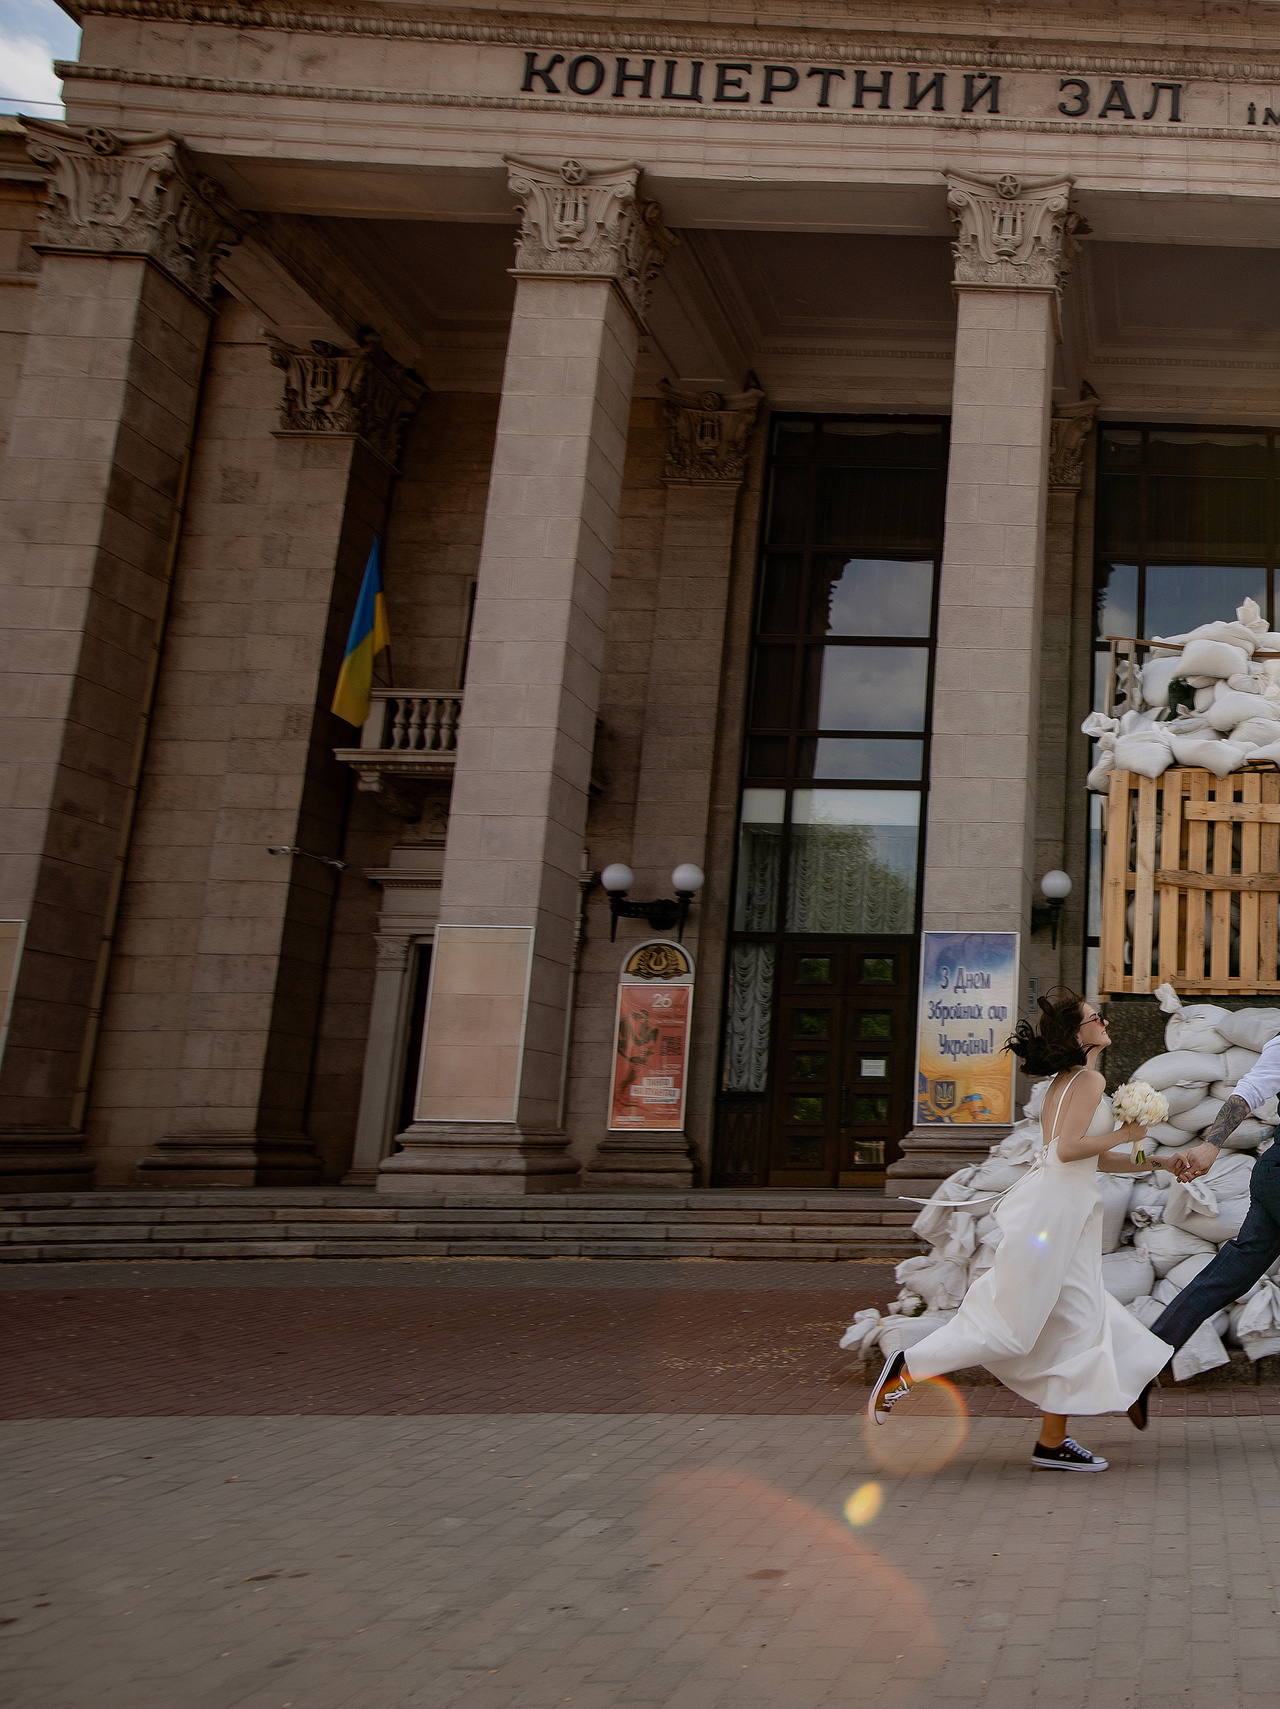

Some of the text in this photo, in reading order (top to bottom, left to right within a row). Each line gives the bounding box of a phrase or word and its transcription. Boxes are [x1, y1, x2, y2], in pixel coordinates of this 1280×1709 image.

[520, 51, 1002, 114] КОНЦЕРТНИЙ
[1057, 77, 1182, 122] ЗАЛ
[954, 967, 991, 994] Днем
[652, 993, 673, 1008] 26
[927, 999, 984, 1026] Збройних
[938, 1027, 995, 1062] України!
